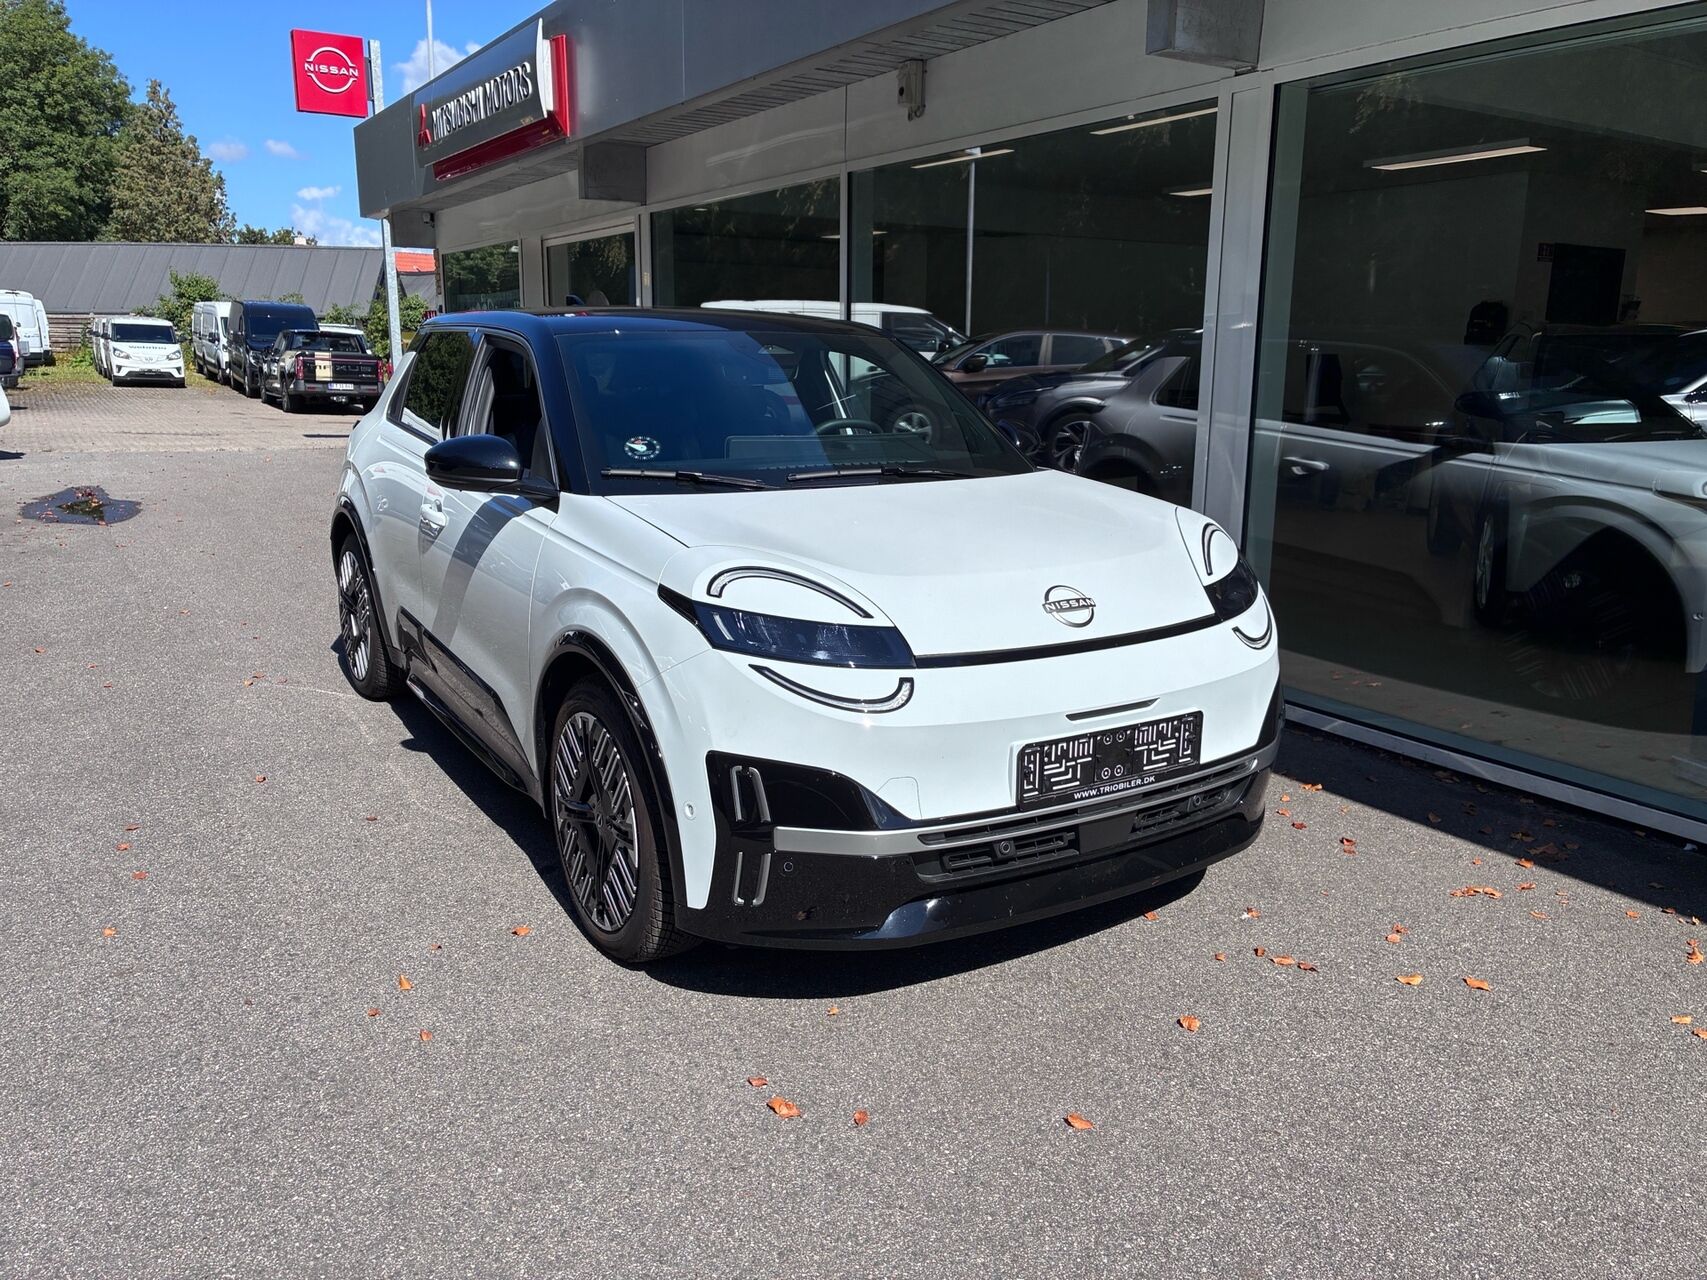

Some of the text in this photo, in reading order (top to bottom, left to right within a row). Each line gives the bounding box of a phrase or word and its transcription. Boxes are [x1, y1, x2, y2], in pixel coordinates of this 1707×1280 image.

[304, 62, 359, 78] NISSAN
[431, 61, 533, 141] MITSUBISHI MOTORS
[1043, 598, 1095, 612] NISSAN
[1073, 775, 1156, 799] WWW.TRIOBILER.DK
